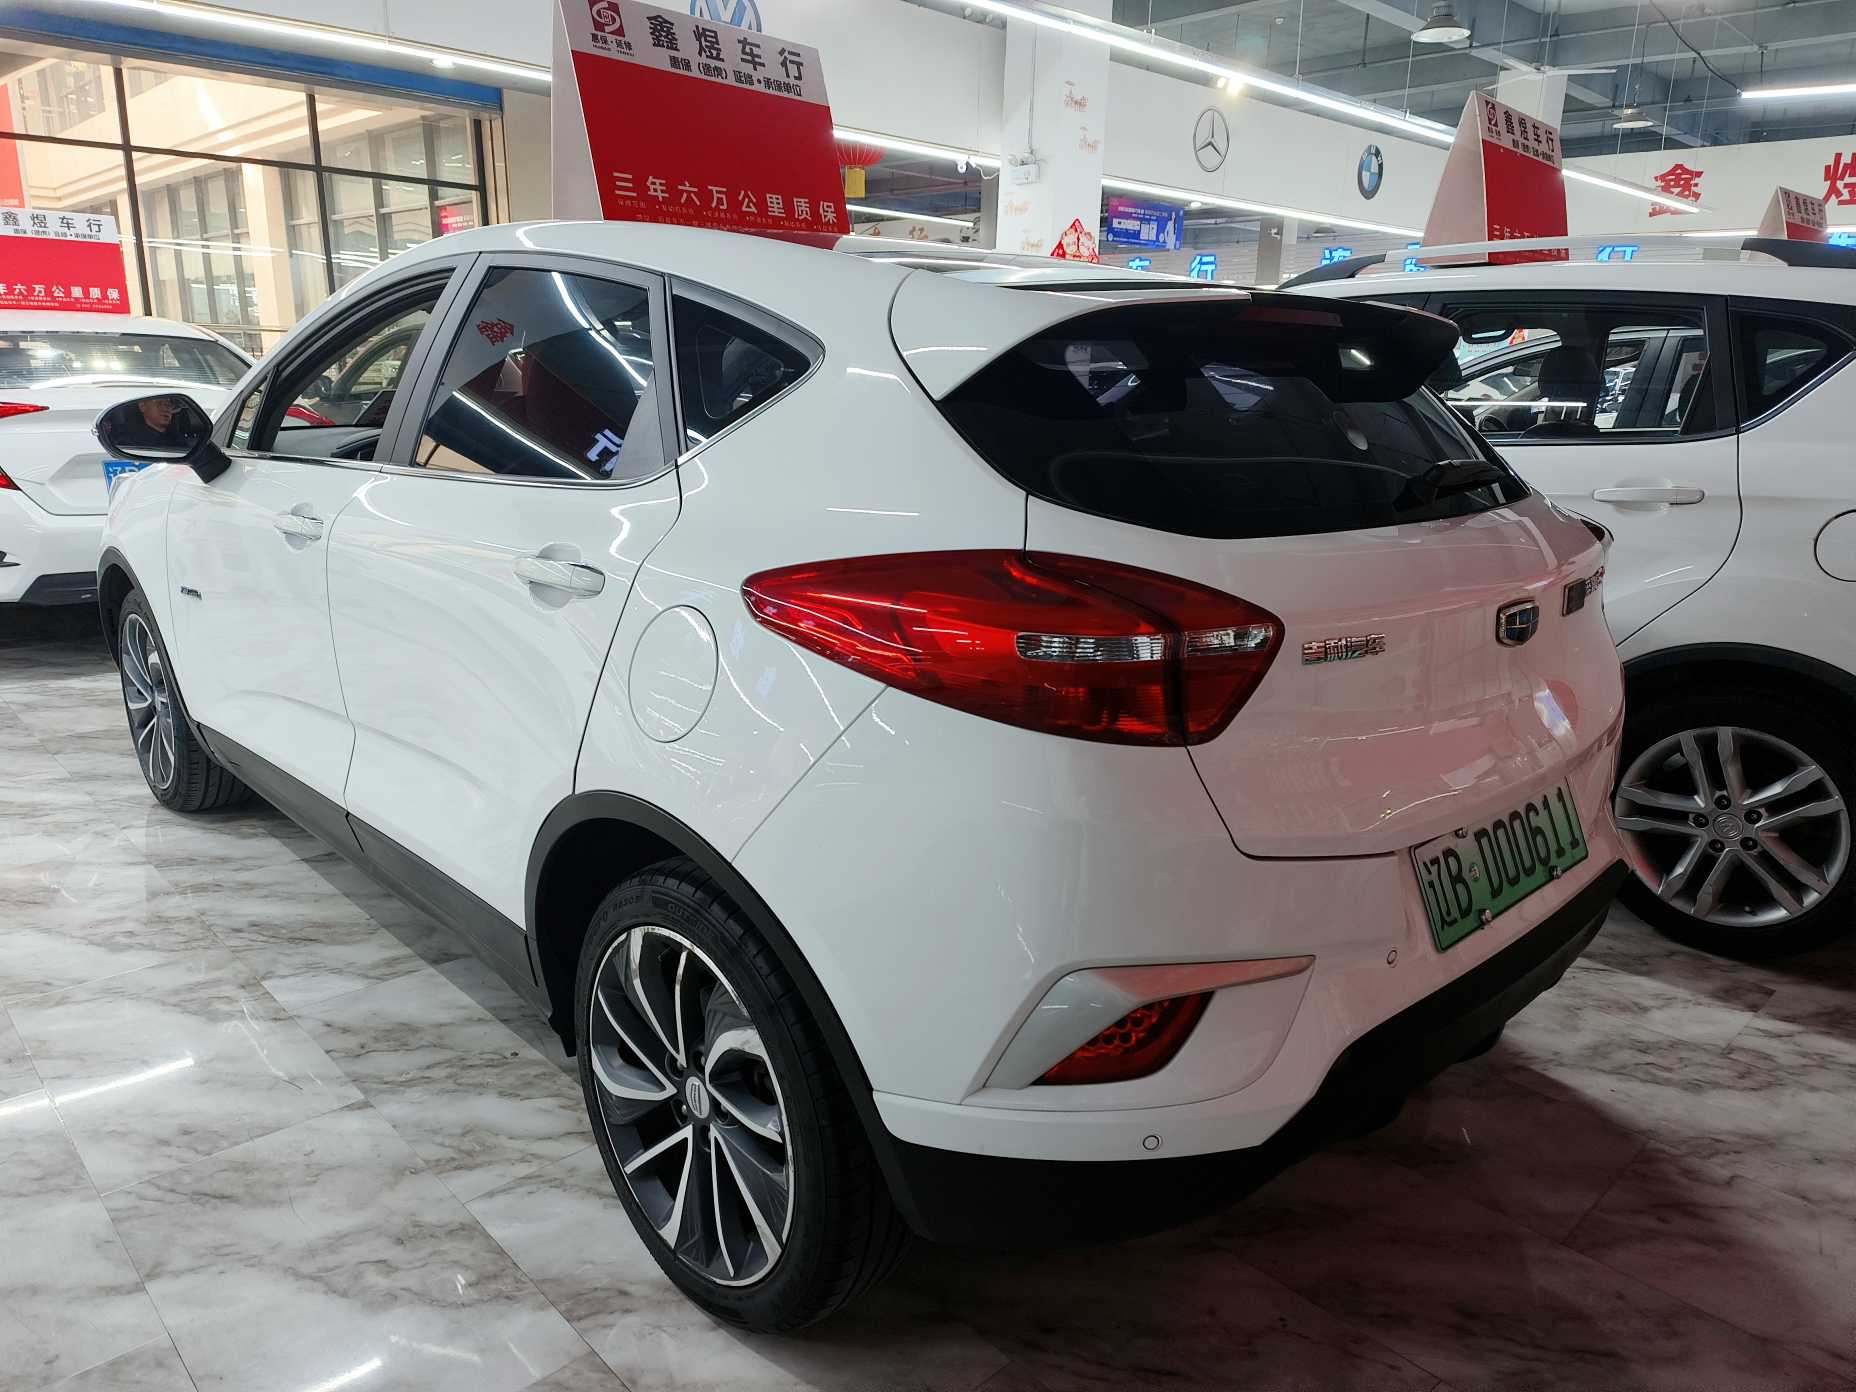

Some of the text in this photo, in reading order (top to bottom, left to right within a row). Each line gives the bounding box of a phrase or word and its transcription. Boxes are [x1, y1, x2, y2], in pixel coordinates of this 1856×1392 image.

[646, 14, 803, 81] 鑫煜车行
[1, 210, 104, 233] 鑫煜车行
[612, 172, 838, 225] 三年六万公里质保
